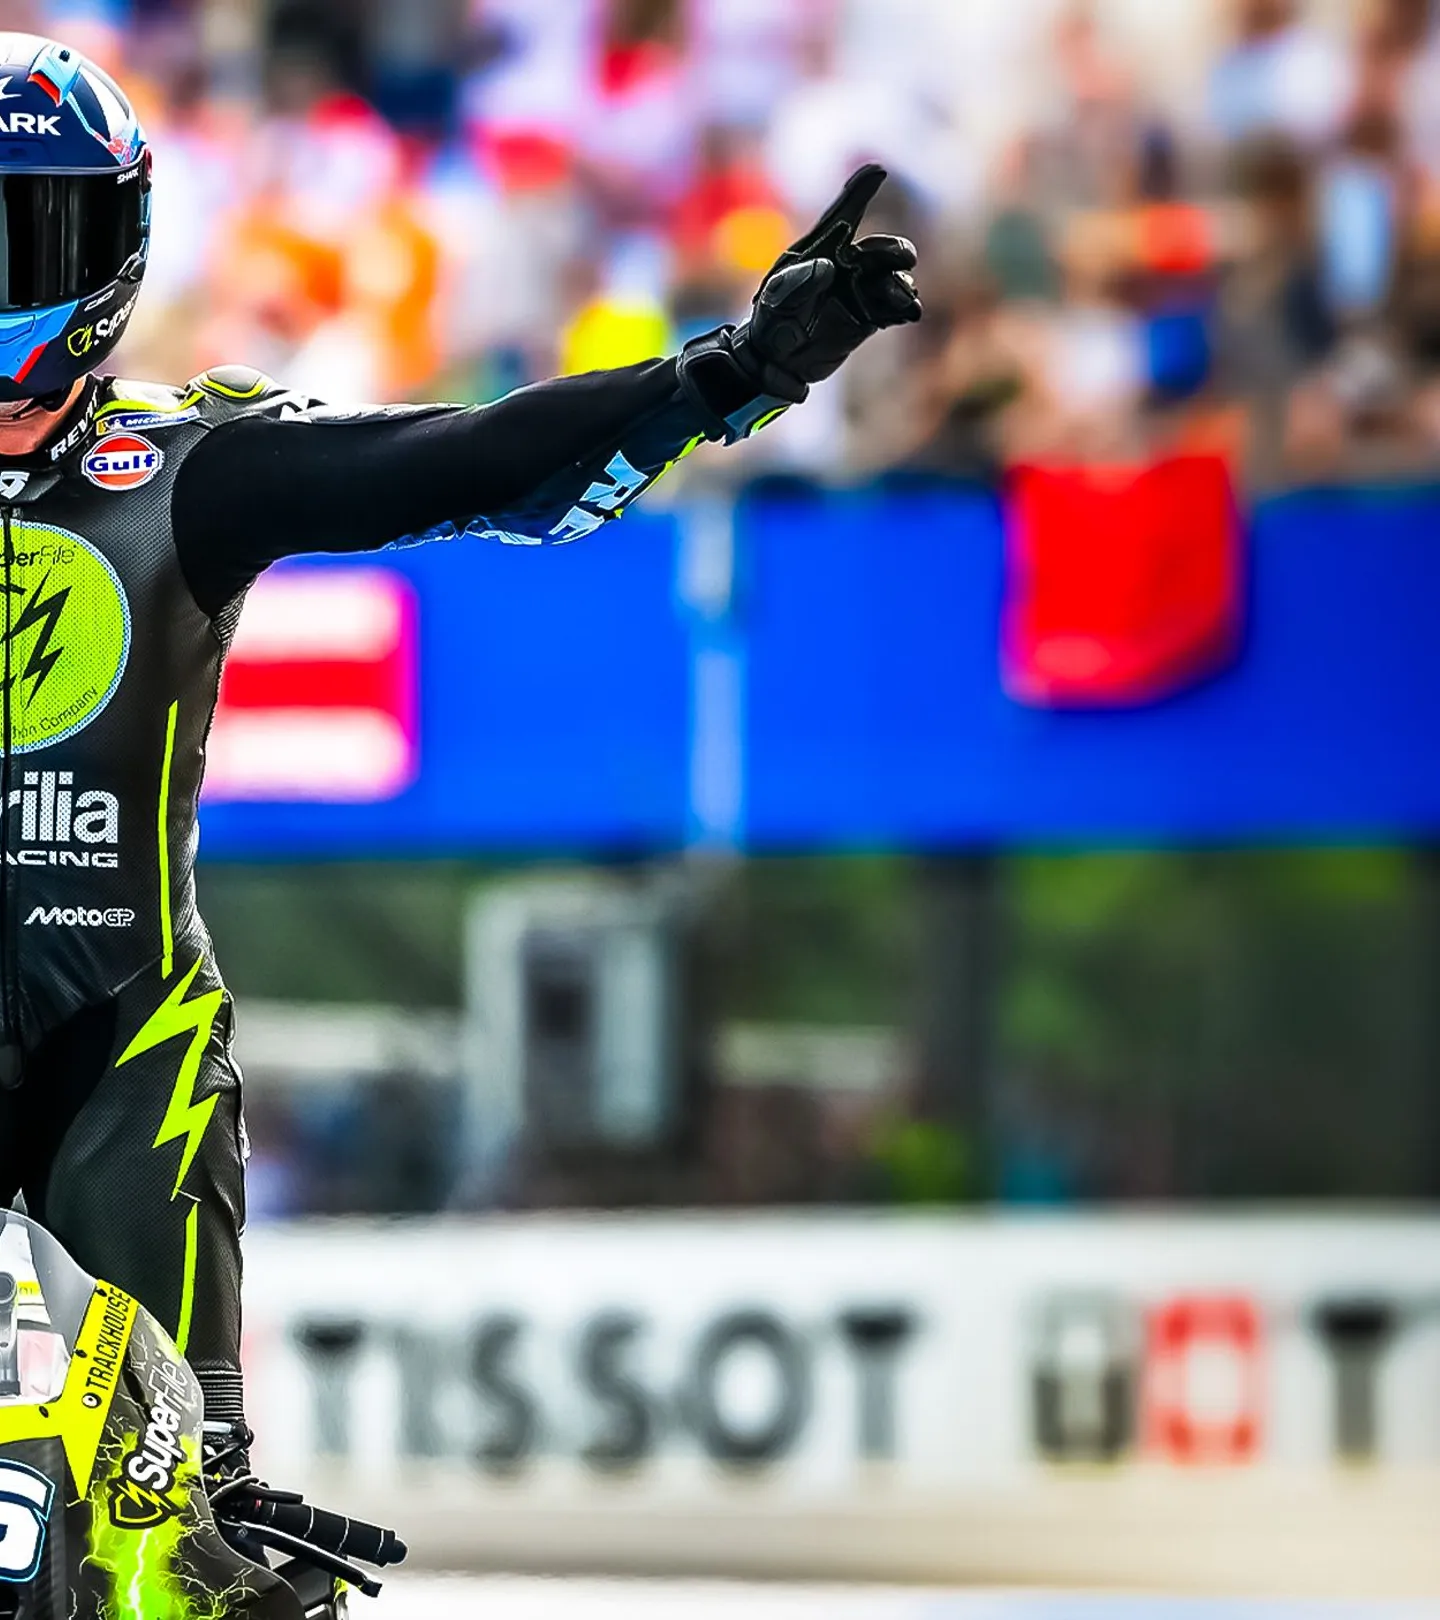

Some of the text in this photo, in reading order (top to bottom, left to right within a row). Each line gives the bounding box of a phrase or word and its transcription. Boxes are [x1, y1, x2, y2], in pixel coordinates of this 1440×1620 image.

[87, 454, 156, 472] Gulf
[40, 687, 98, 731] Company
[24, 907, 135, 927] MotoGP
[86, 1287, 131, 1391] TRACKHOUSE
[290, 1308, 915, 1460] TISSOT
[128, 1357, 188, 1491] SuperFile
